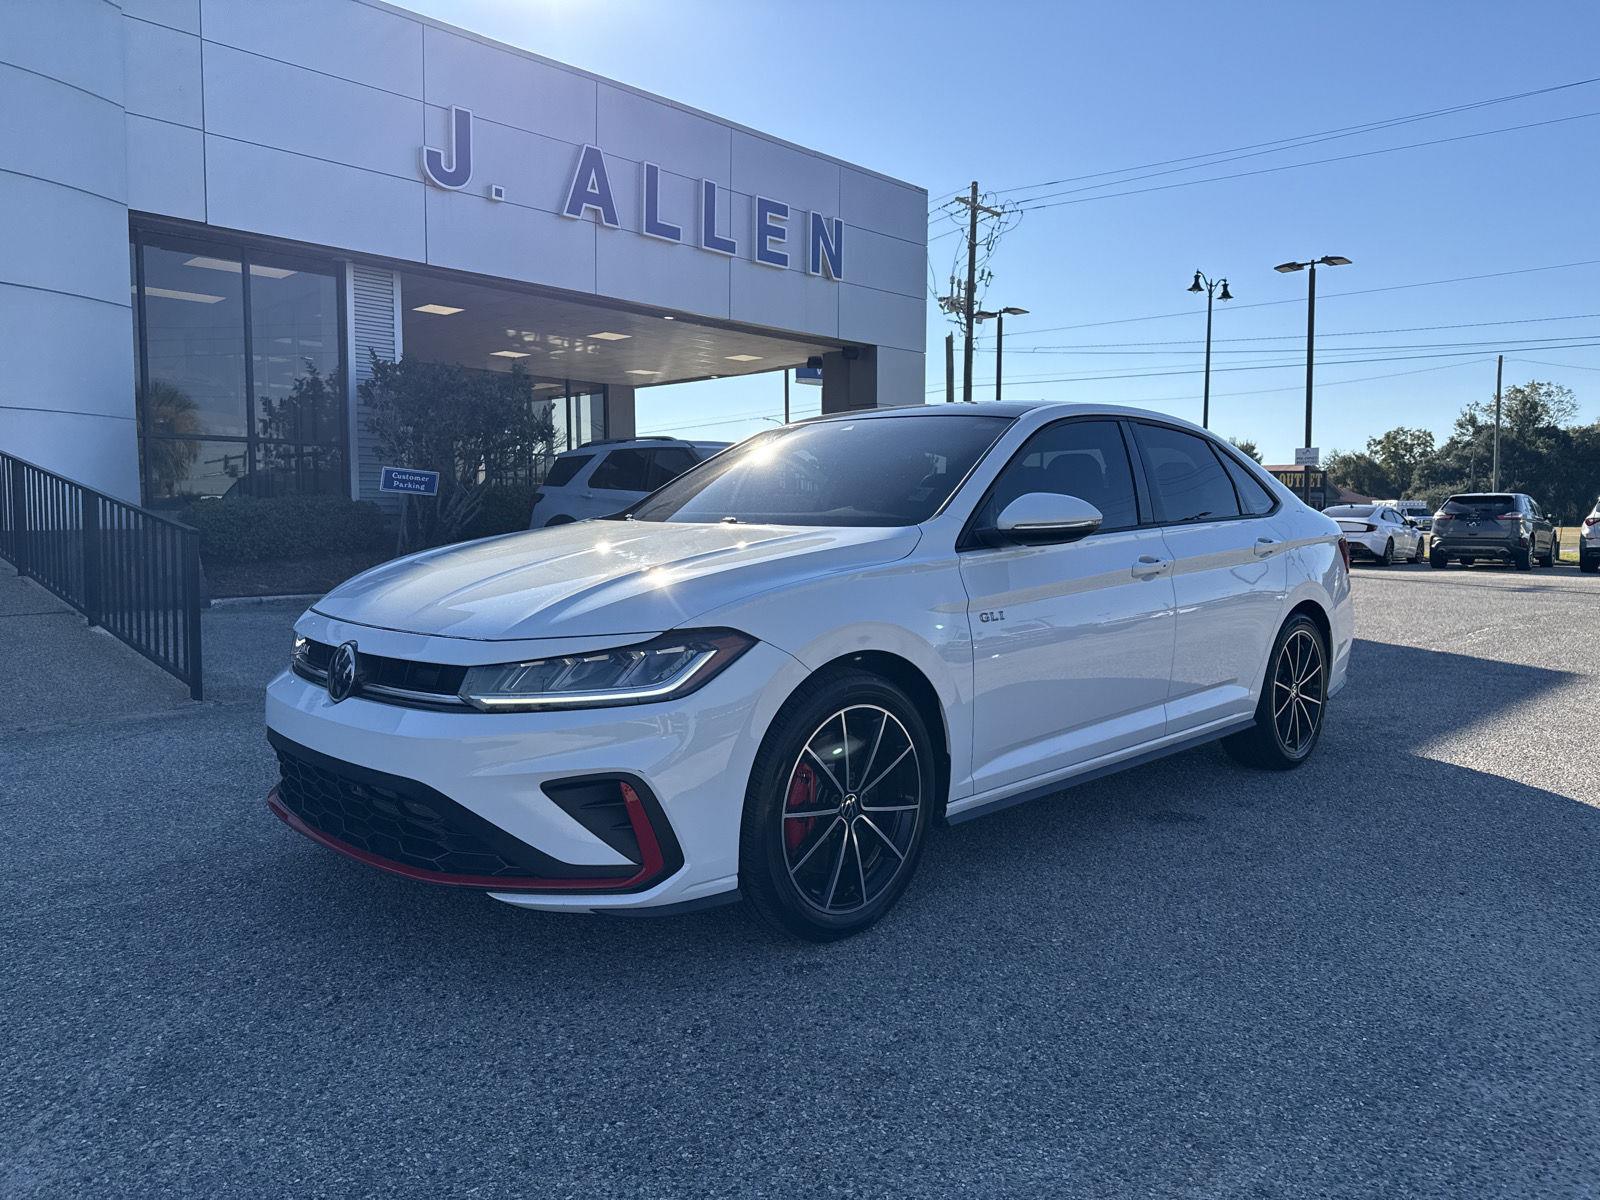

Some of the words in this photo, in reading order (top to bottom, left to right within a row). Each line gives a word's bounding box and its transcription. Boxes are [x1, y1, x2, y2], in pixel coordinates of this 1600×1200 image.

[420, 104, 505, 201] J.
[562, 143, 844, 281] ALLEN
[392, 472, 430, 482] Customer
[1280, 473, 1323, 488] OUTET
[393, 480, 425, 490] Parking
[979, 610, 1005, 623] GLI
